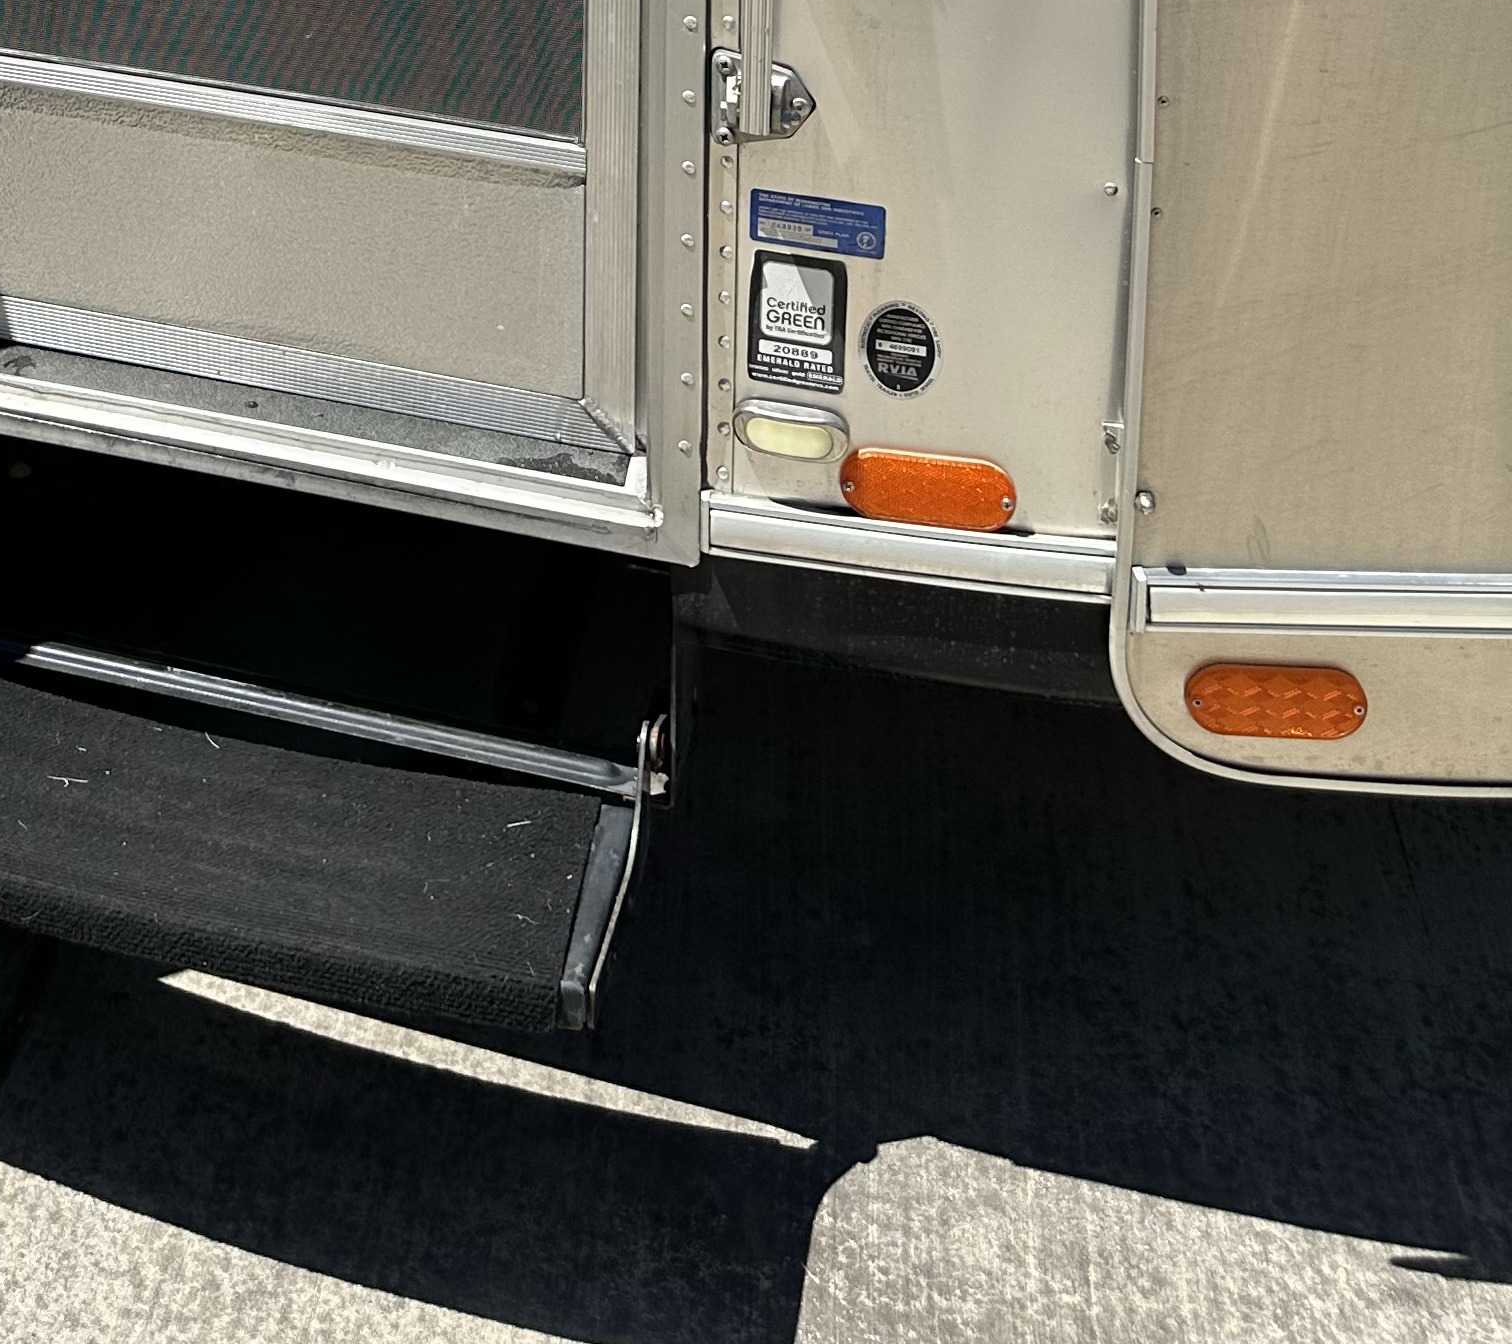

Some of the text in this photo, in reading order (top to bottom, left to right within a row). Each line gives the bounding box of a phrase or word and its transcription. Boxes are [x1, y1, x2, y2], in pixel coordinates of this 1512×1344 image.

[766, 297, 826, 316] Certified
[773, 344, 818, 359] 20889
[757, 353, 833, 373] EMERALD RATED
[877, 362, 918, 377] RVIA
